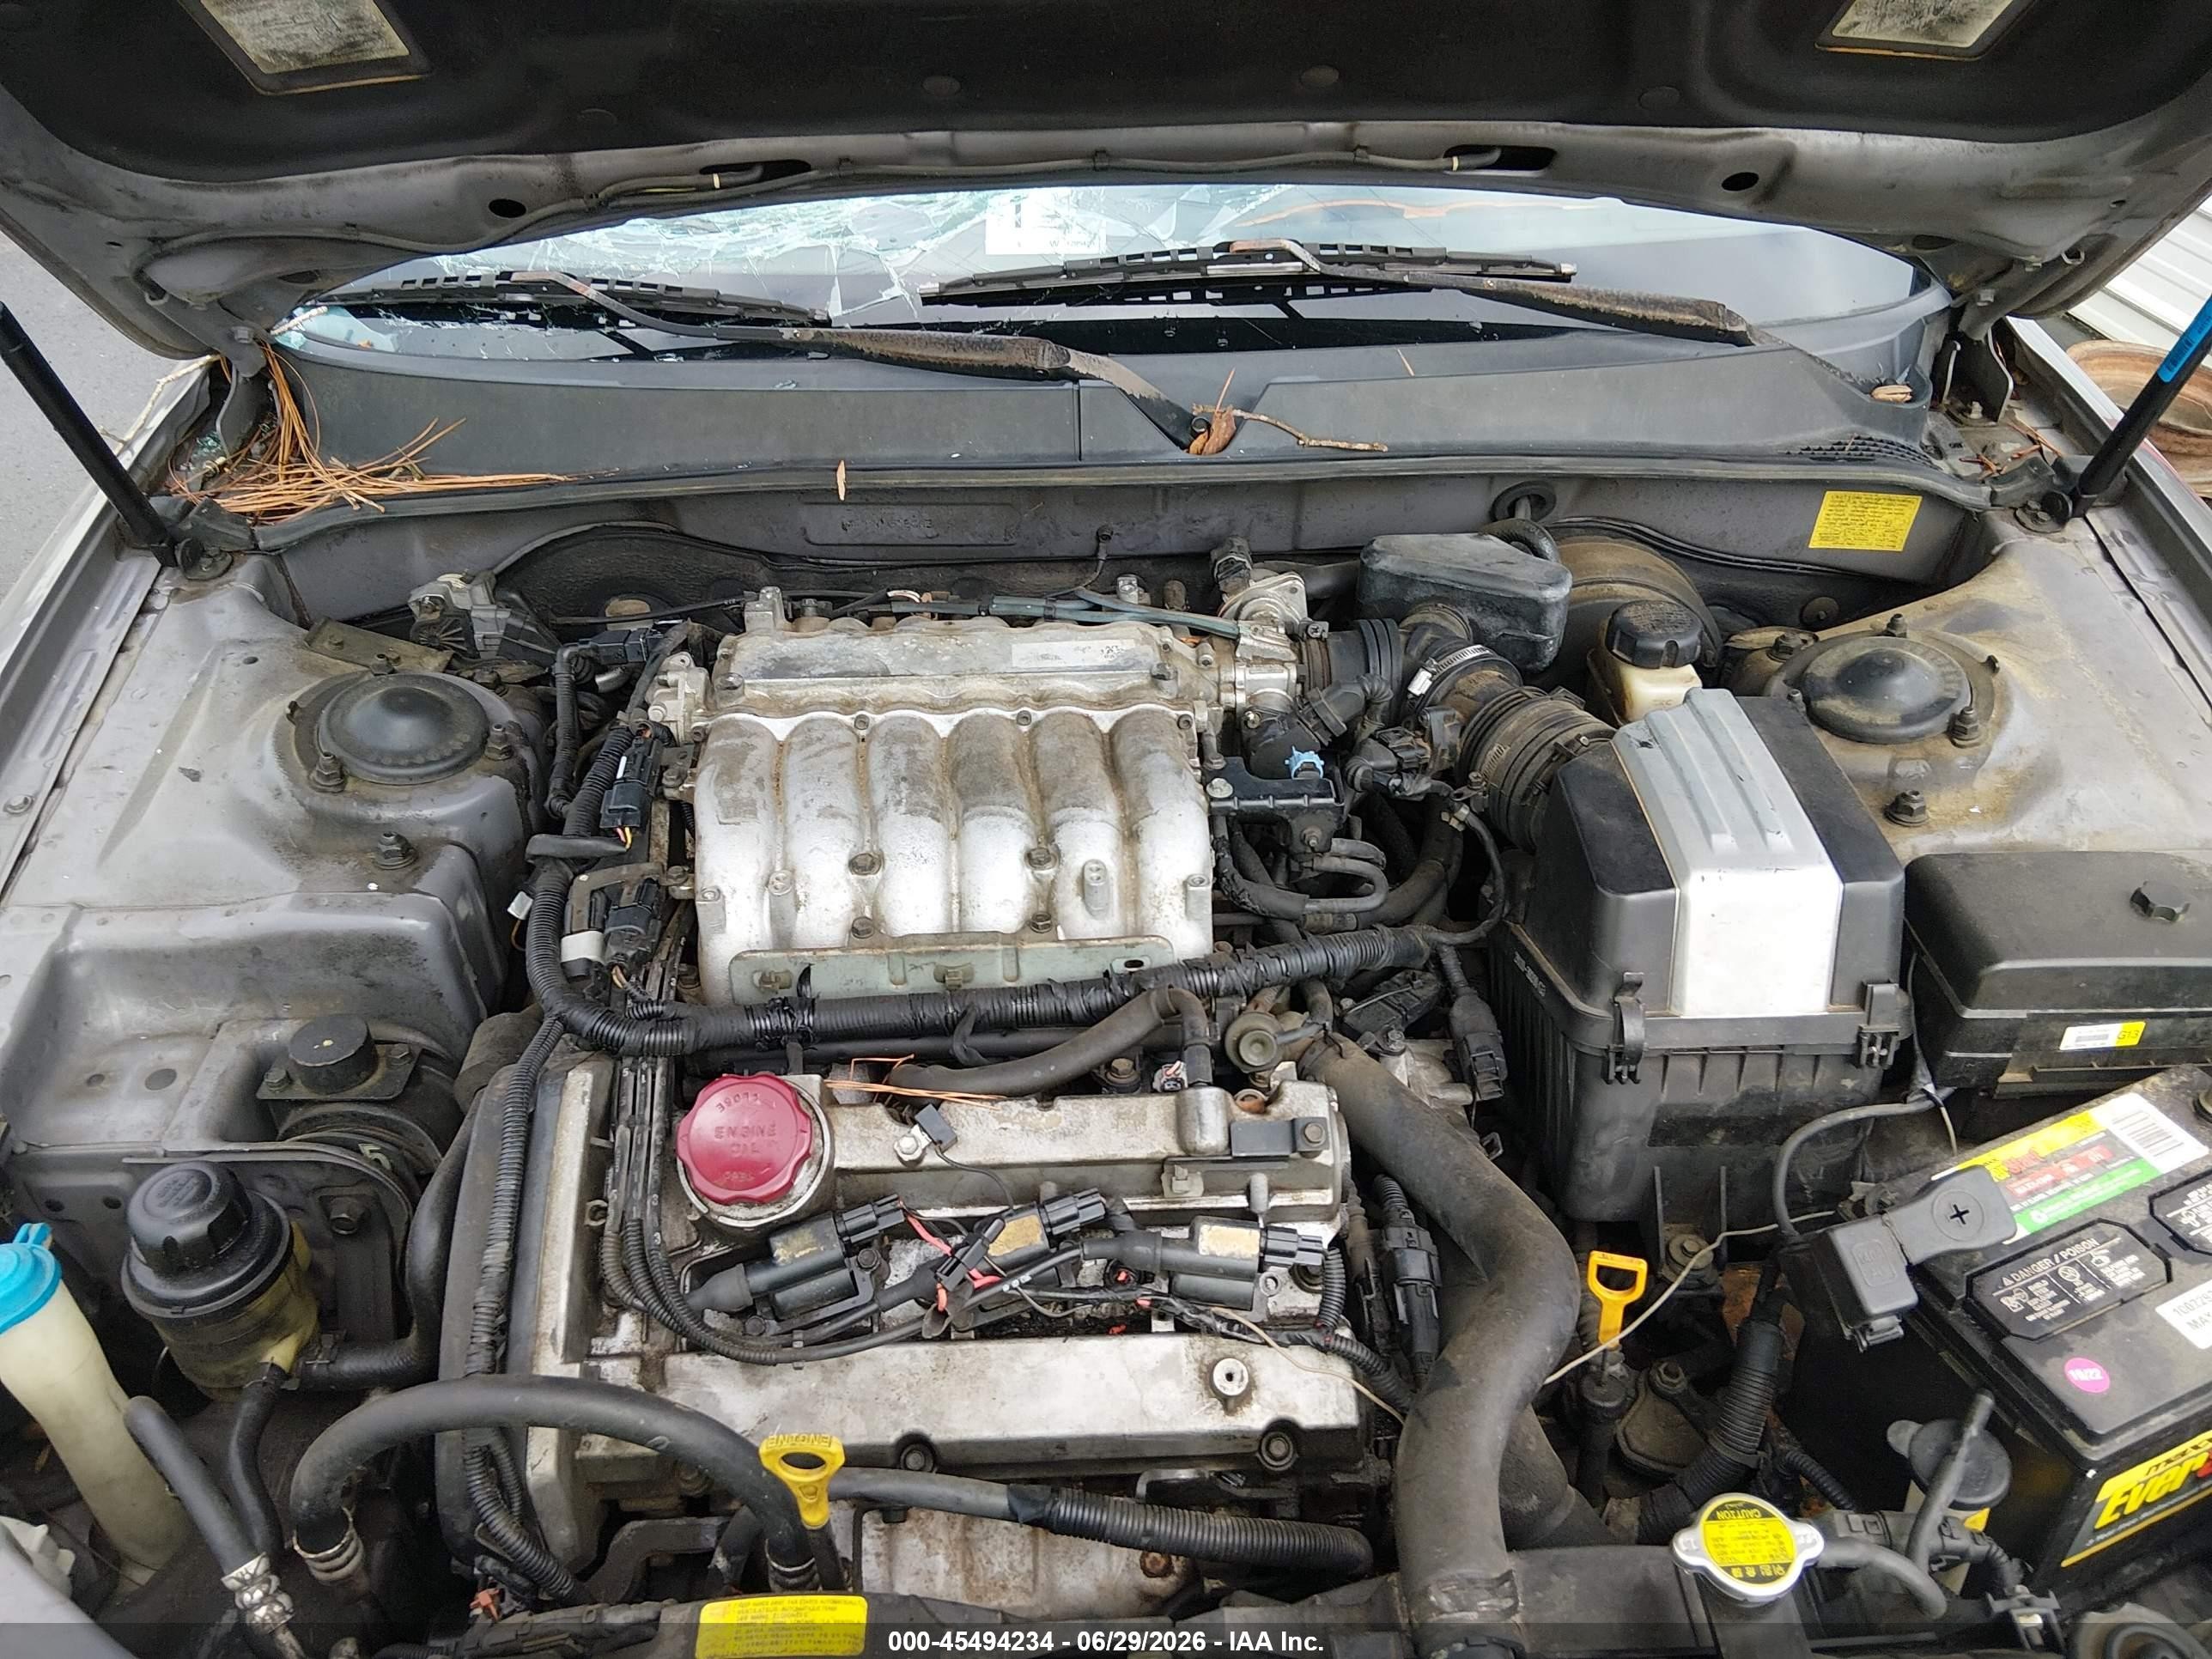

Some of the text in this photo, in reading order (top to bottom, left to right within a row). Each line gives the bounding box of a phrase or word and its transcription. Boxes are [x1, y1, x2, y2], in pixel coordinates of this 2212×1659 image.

[714, 1123, 777, 1140] ENGINE
[2009, 1257, 2056, 1282] DANGER
[2059, 1237, 2100, 1261] POISON
[766, 1433, 832, 1449] ENGINE
[1716, 1507, 1762, 1520] CAUTION
